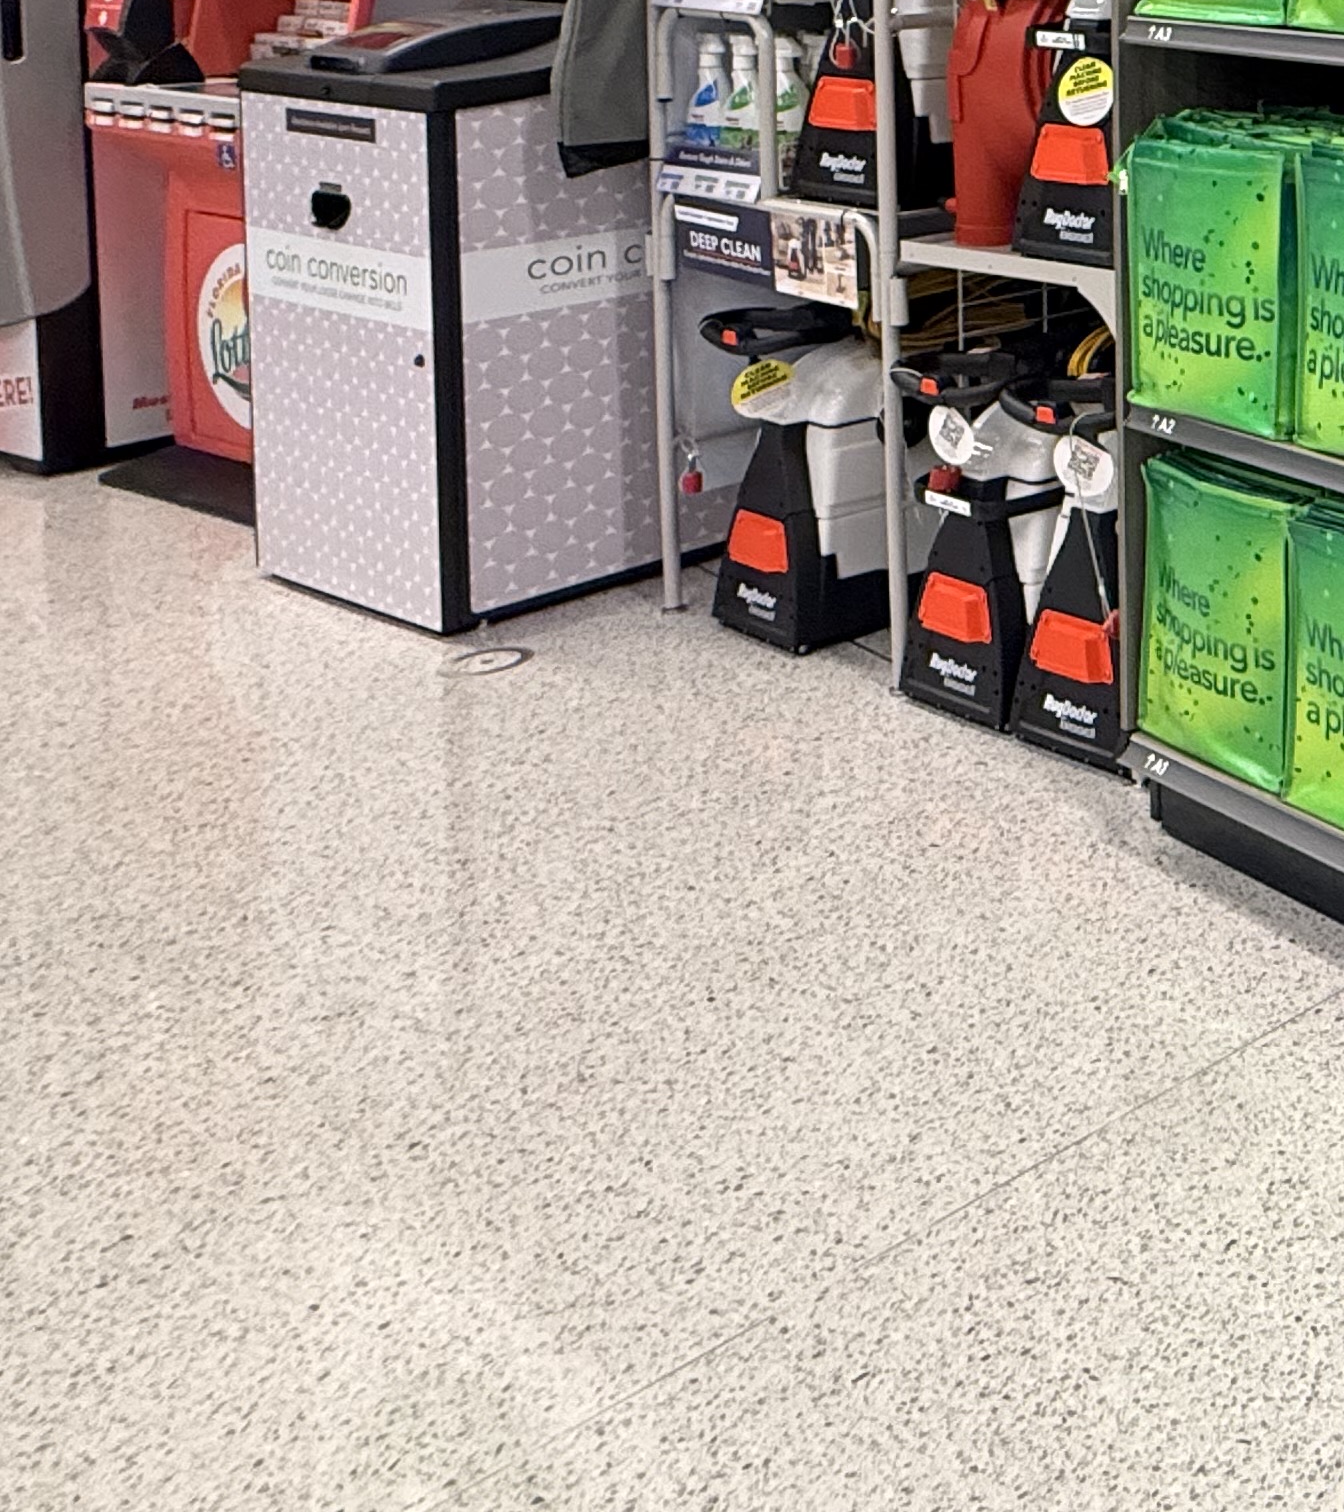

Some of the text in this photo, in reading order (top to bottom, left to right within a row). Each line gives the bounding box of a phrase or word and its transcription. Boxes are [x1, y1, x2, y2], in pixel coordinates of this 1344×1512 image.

[689, 230, 762, 262] DEEP CLEAN
[266, 244, 301, 273] coin
[307, 256, 408, 296] conversion
[528, 245, 606, 280] coin
[1306, 348, 1318, 374] a
[1306, 700, 1320, 726] a
